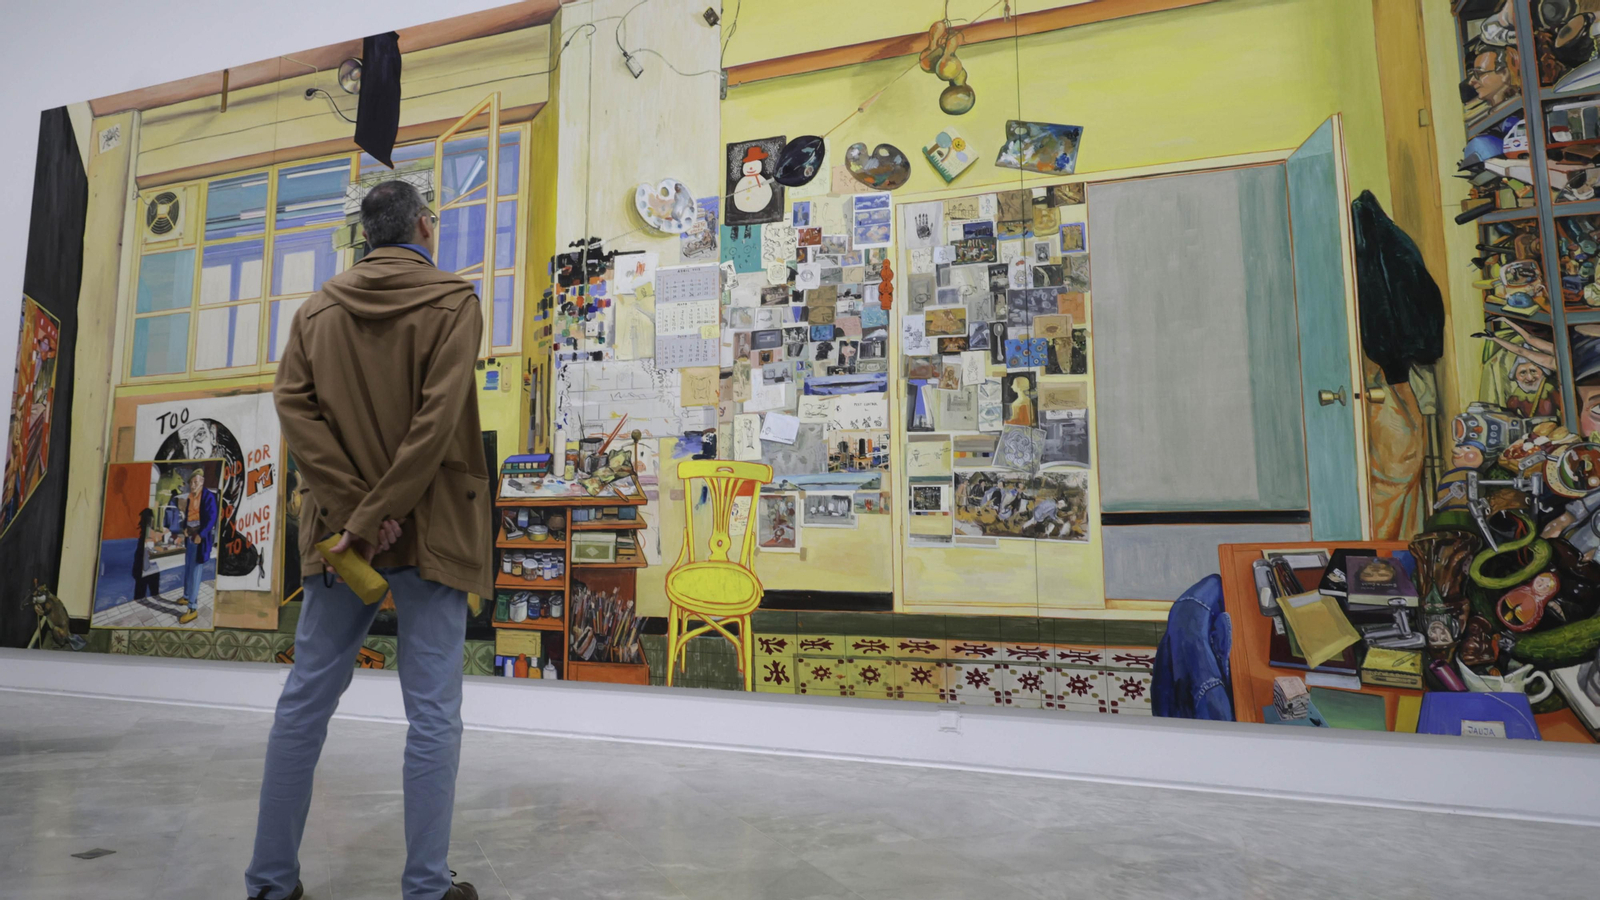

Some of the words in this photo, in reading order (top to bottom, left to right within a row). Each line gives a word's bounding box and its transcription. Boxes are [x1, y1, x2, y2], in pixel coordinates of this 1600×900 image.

[156, 407, 189, 435] TOO
[224, 460, 243, 480] OLD
[247, 444, 271, 468] FOR
[225, 538, 242, 555] TO
[246, 521, 270, 549] DIE!
[229, 505, 270, 538] YOUNG
[1467, 725, 1496, 737] JAUJA
